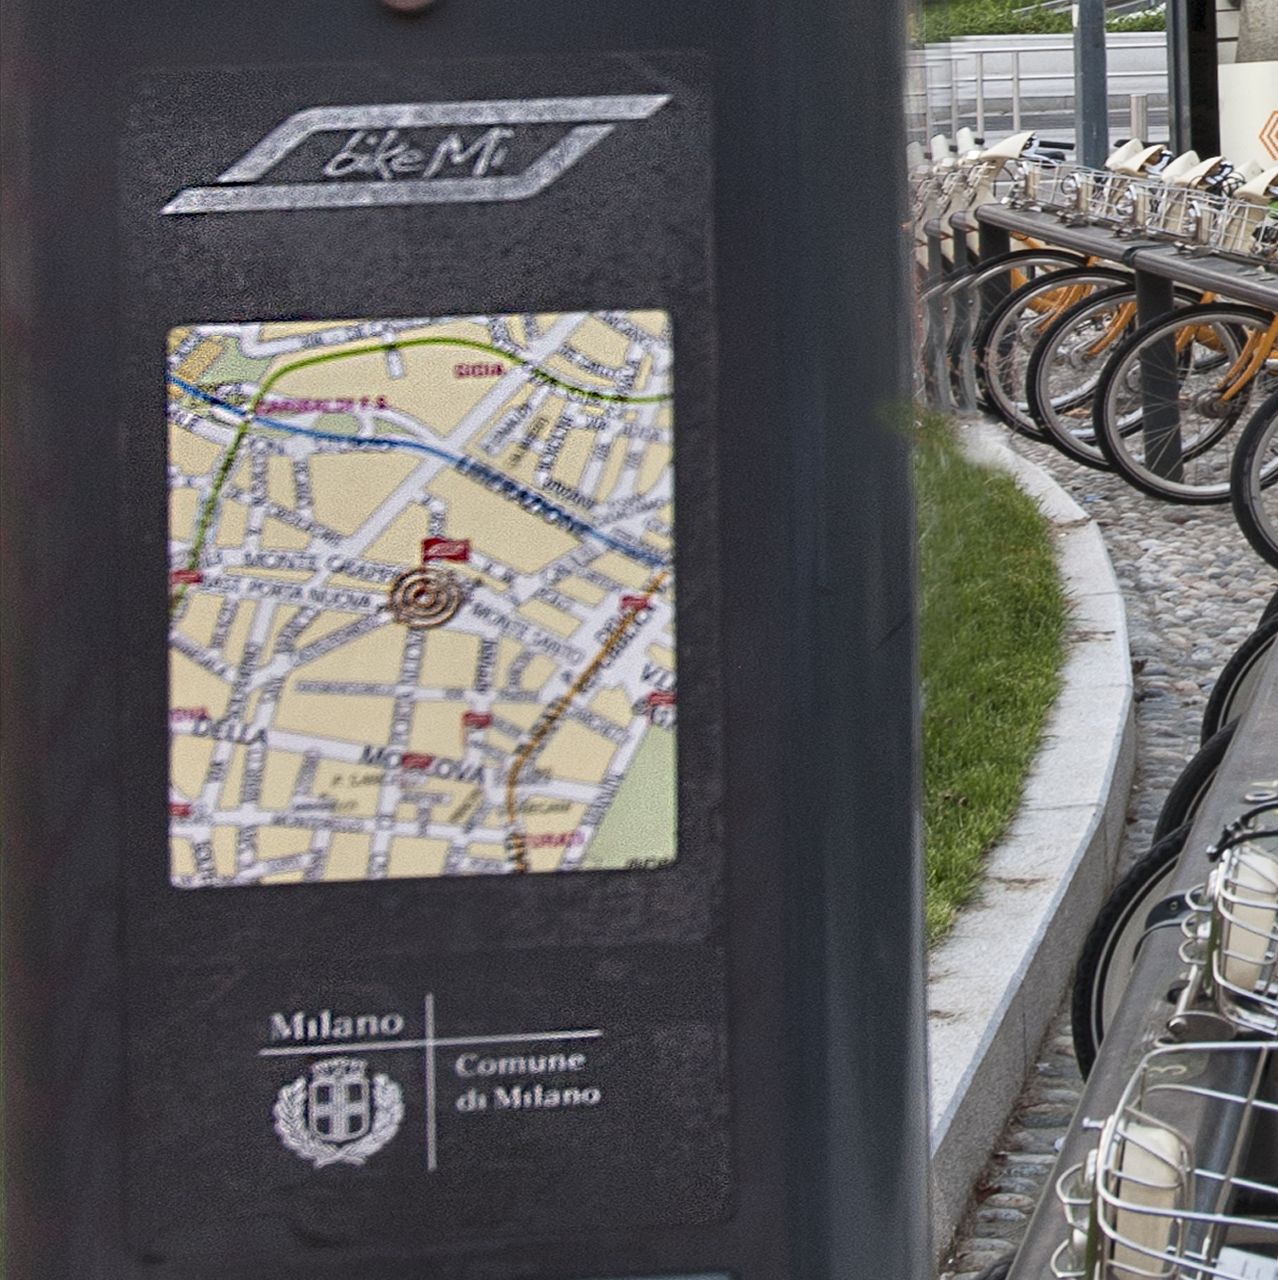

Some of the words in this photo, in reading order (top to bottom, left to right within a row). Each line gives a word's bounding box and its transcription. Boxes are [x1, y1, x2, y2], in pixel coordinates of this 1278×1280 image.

[269, 1009, 405, 1041] Milano
[455, 1053, 587, 1077] Comune
[456, 1087, 487, 1112] di
[494, 1083, 602, 1110] Milano
